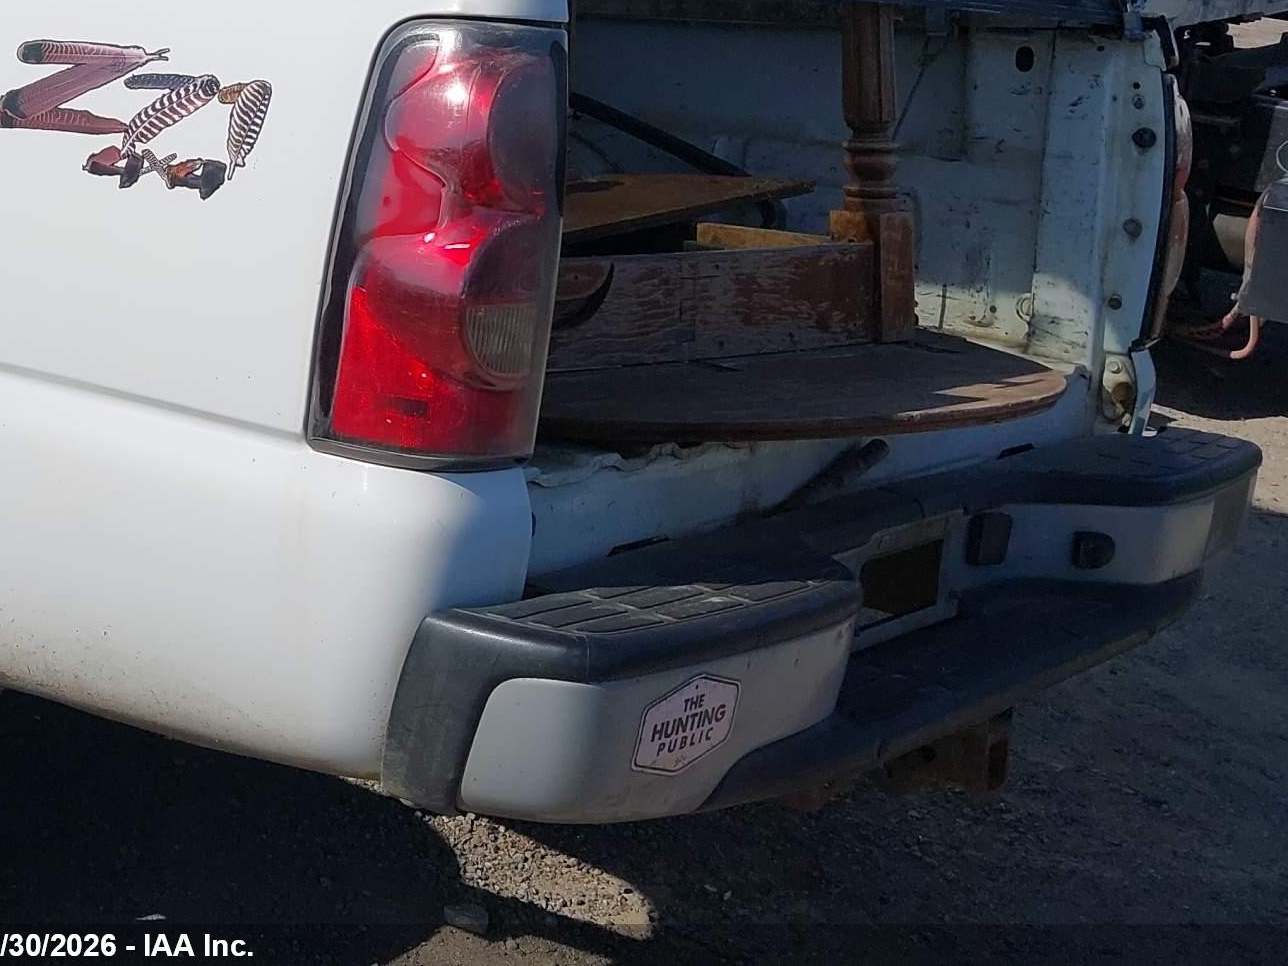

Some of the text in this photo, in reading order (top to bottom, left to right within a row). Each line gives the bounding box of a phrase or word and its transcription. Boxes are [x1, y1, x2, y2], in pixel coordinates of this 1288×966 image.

[683, 693, 706, 713] THE
[650, 704, 726, 742] HUNTING
[656, 727, 713, 756] PUBLIC
